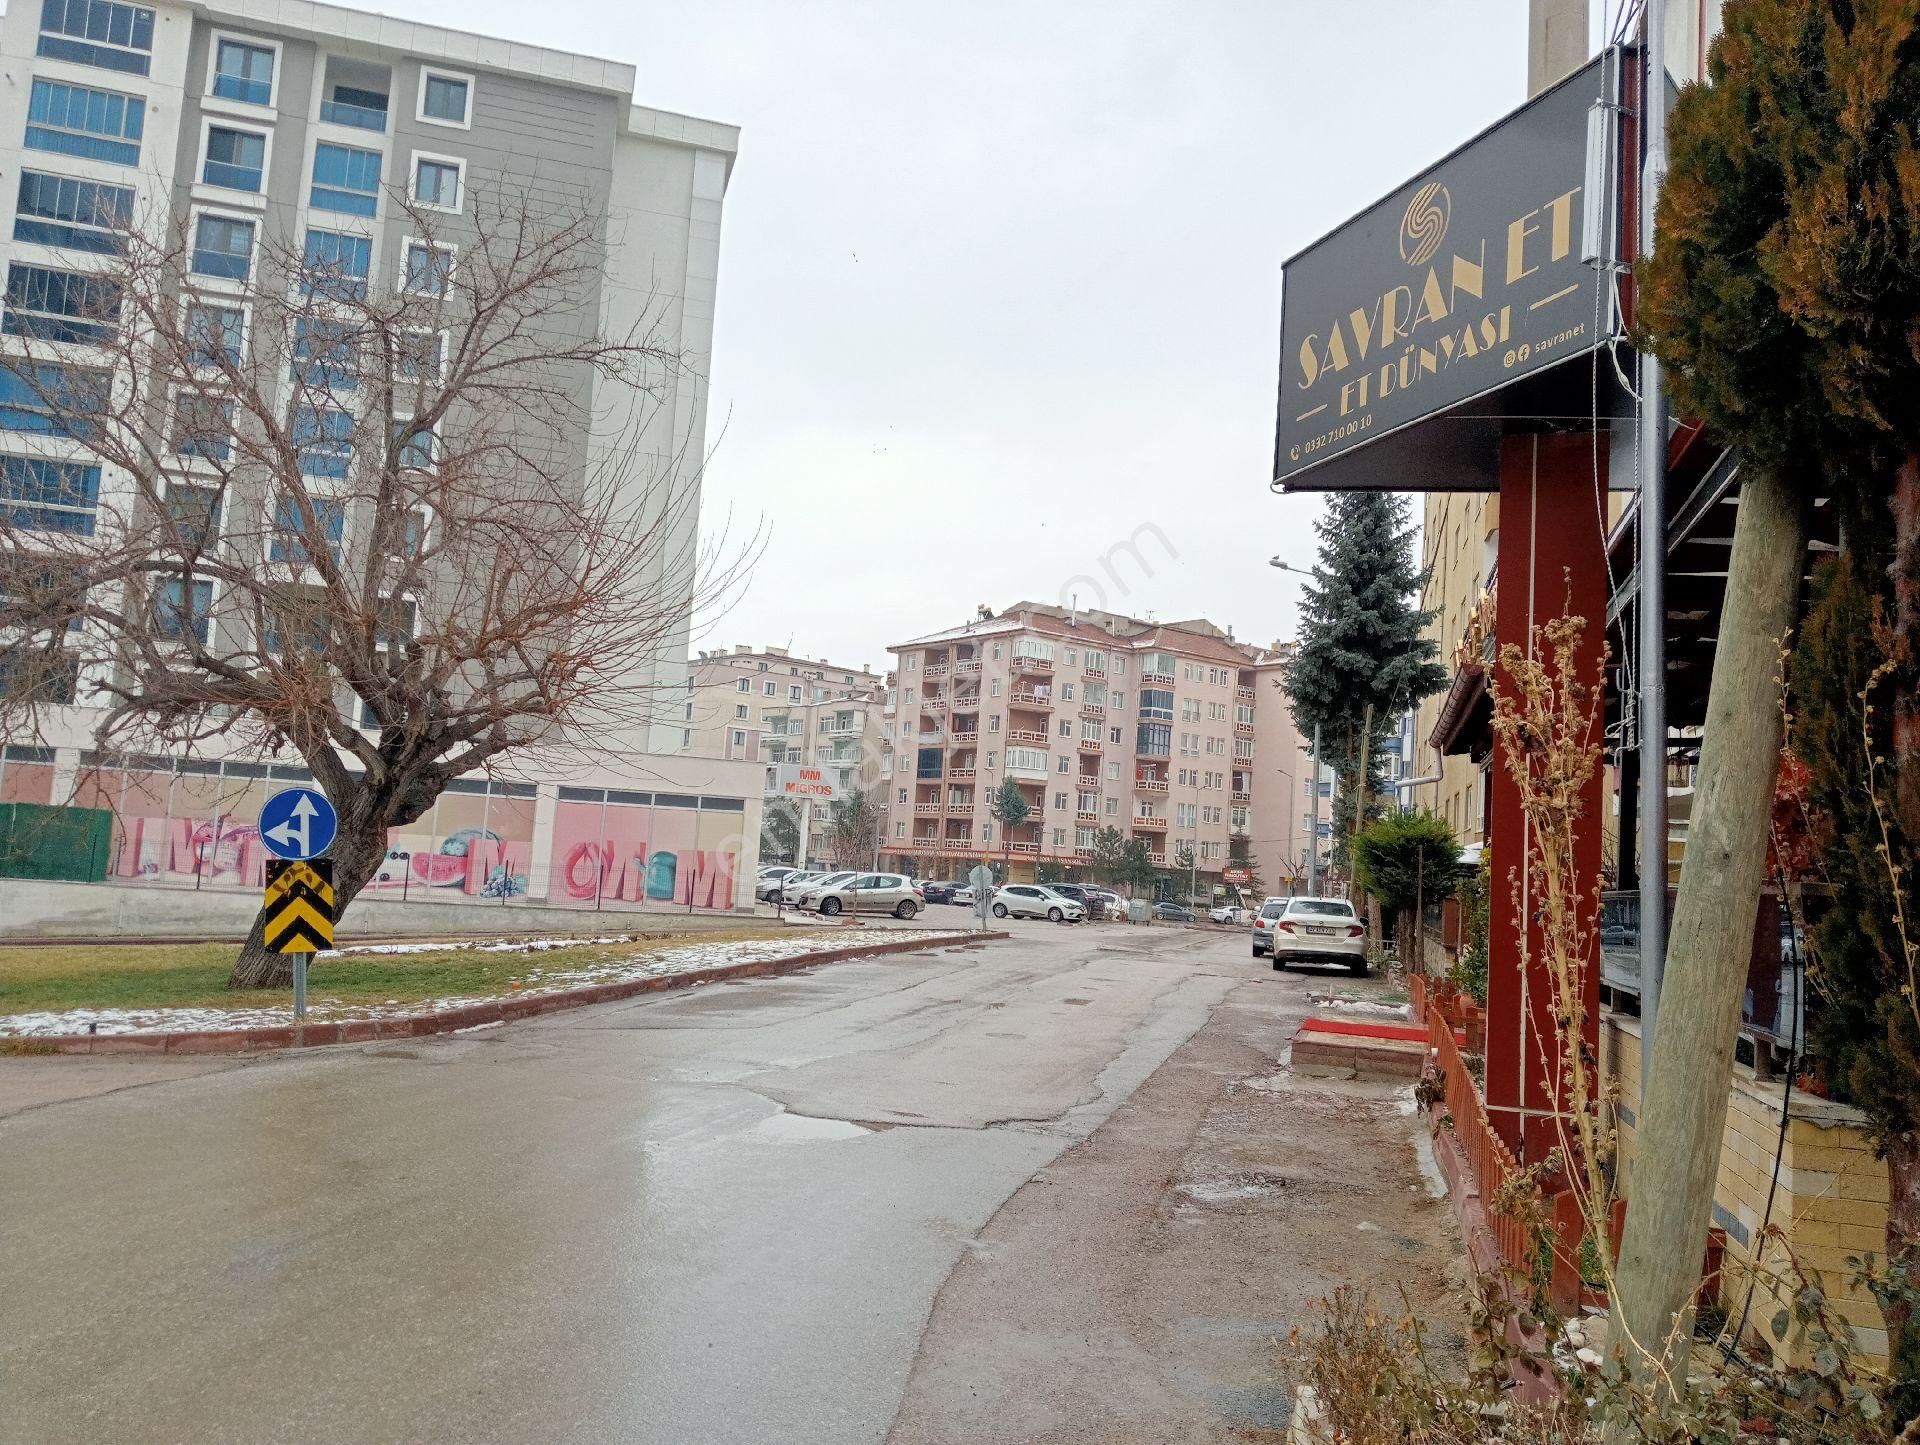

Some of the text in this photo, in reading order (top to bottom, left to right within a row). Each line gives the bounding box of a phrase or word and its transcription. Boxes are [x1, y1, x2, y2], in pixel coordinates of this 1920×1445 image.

[1298, 186, 1582, 390] SAVRAN ET
[1535, 322, 1585, 353] savranet
[1340, 304, 1511, 417] ET DÜNYASI
[1304, 414, 1372, 454] 0332 710 00 10
[799, 769, 821, 781] MM
